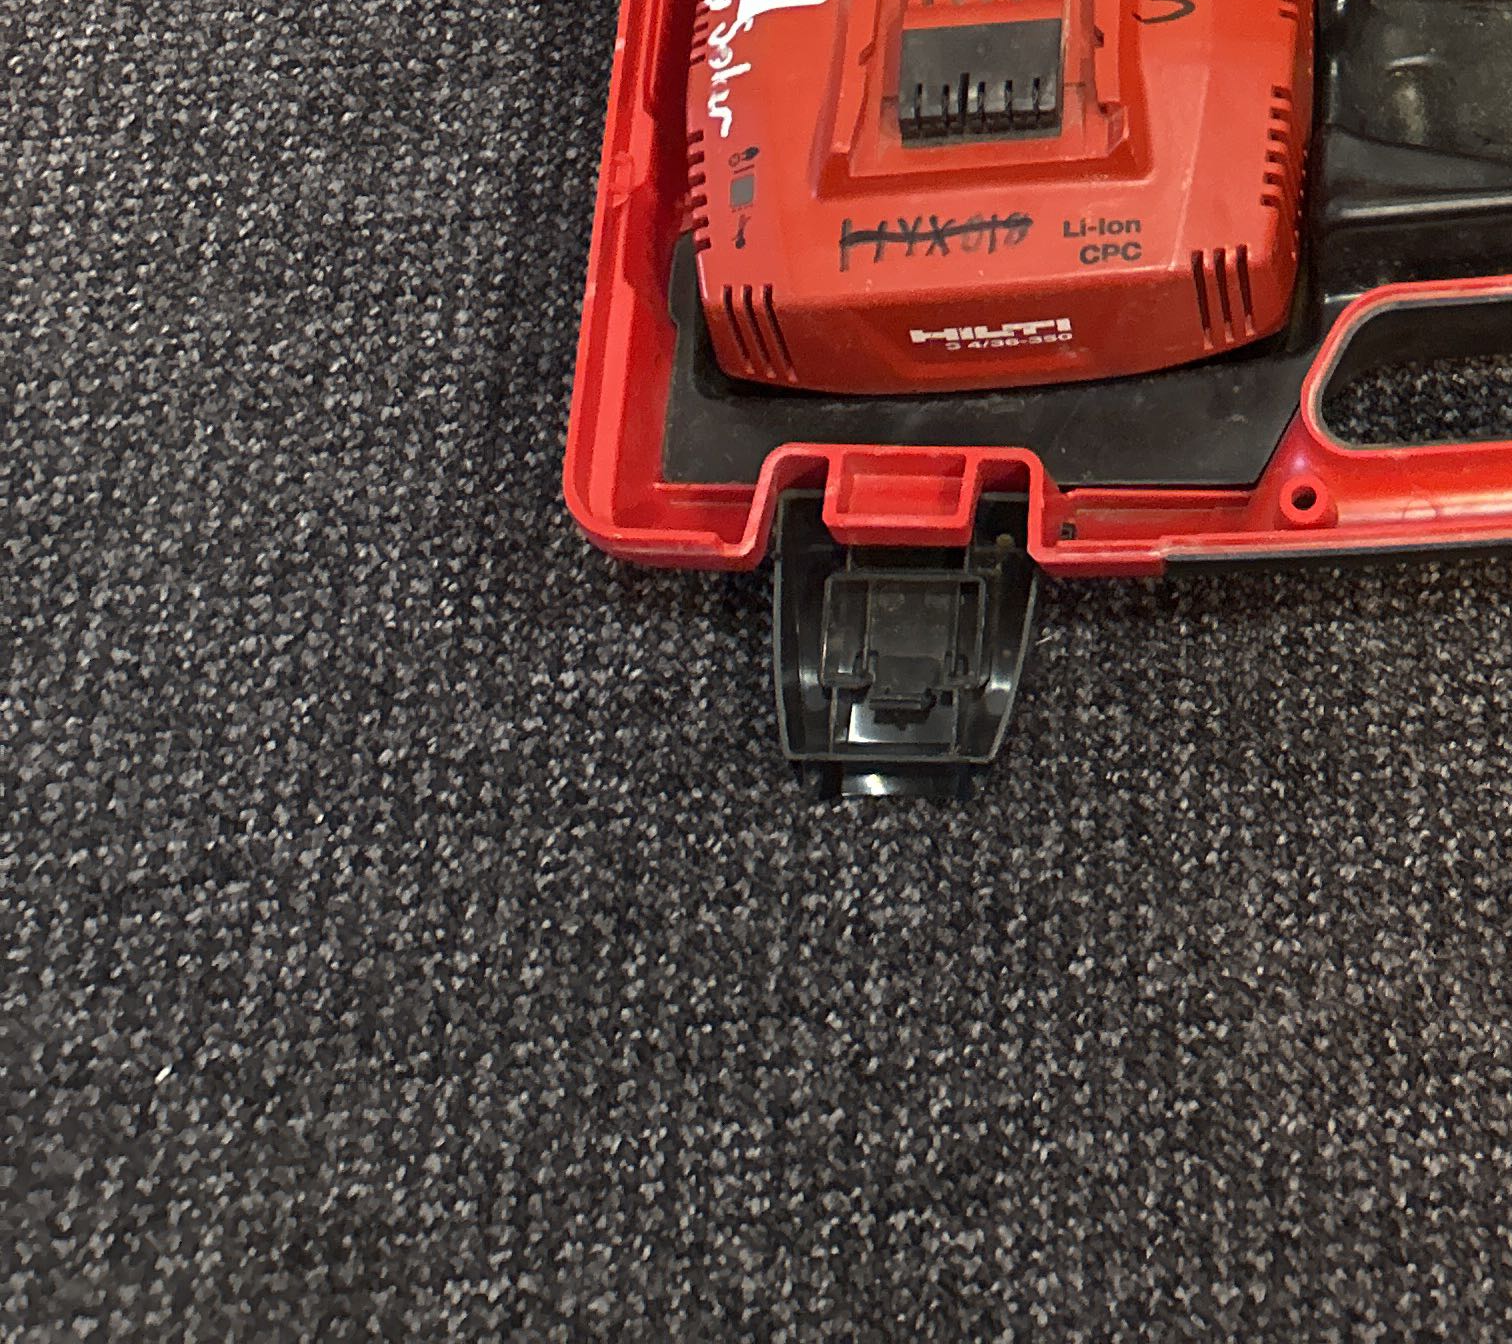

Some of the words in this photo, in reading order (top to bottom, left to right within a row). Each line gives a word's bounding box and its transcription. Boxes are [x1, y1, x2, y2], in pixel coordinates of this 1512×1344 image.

[1062, 217, 1142, 239] Li-Ion
[1078, 240, 1143, 265] CPC
[909, 317, 1072, 344] HILTI
